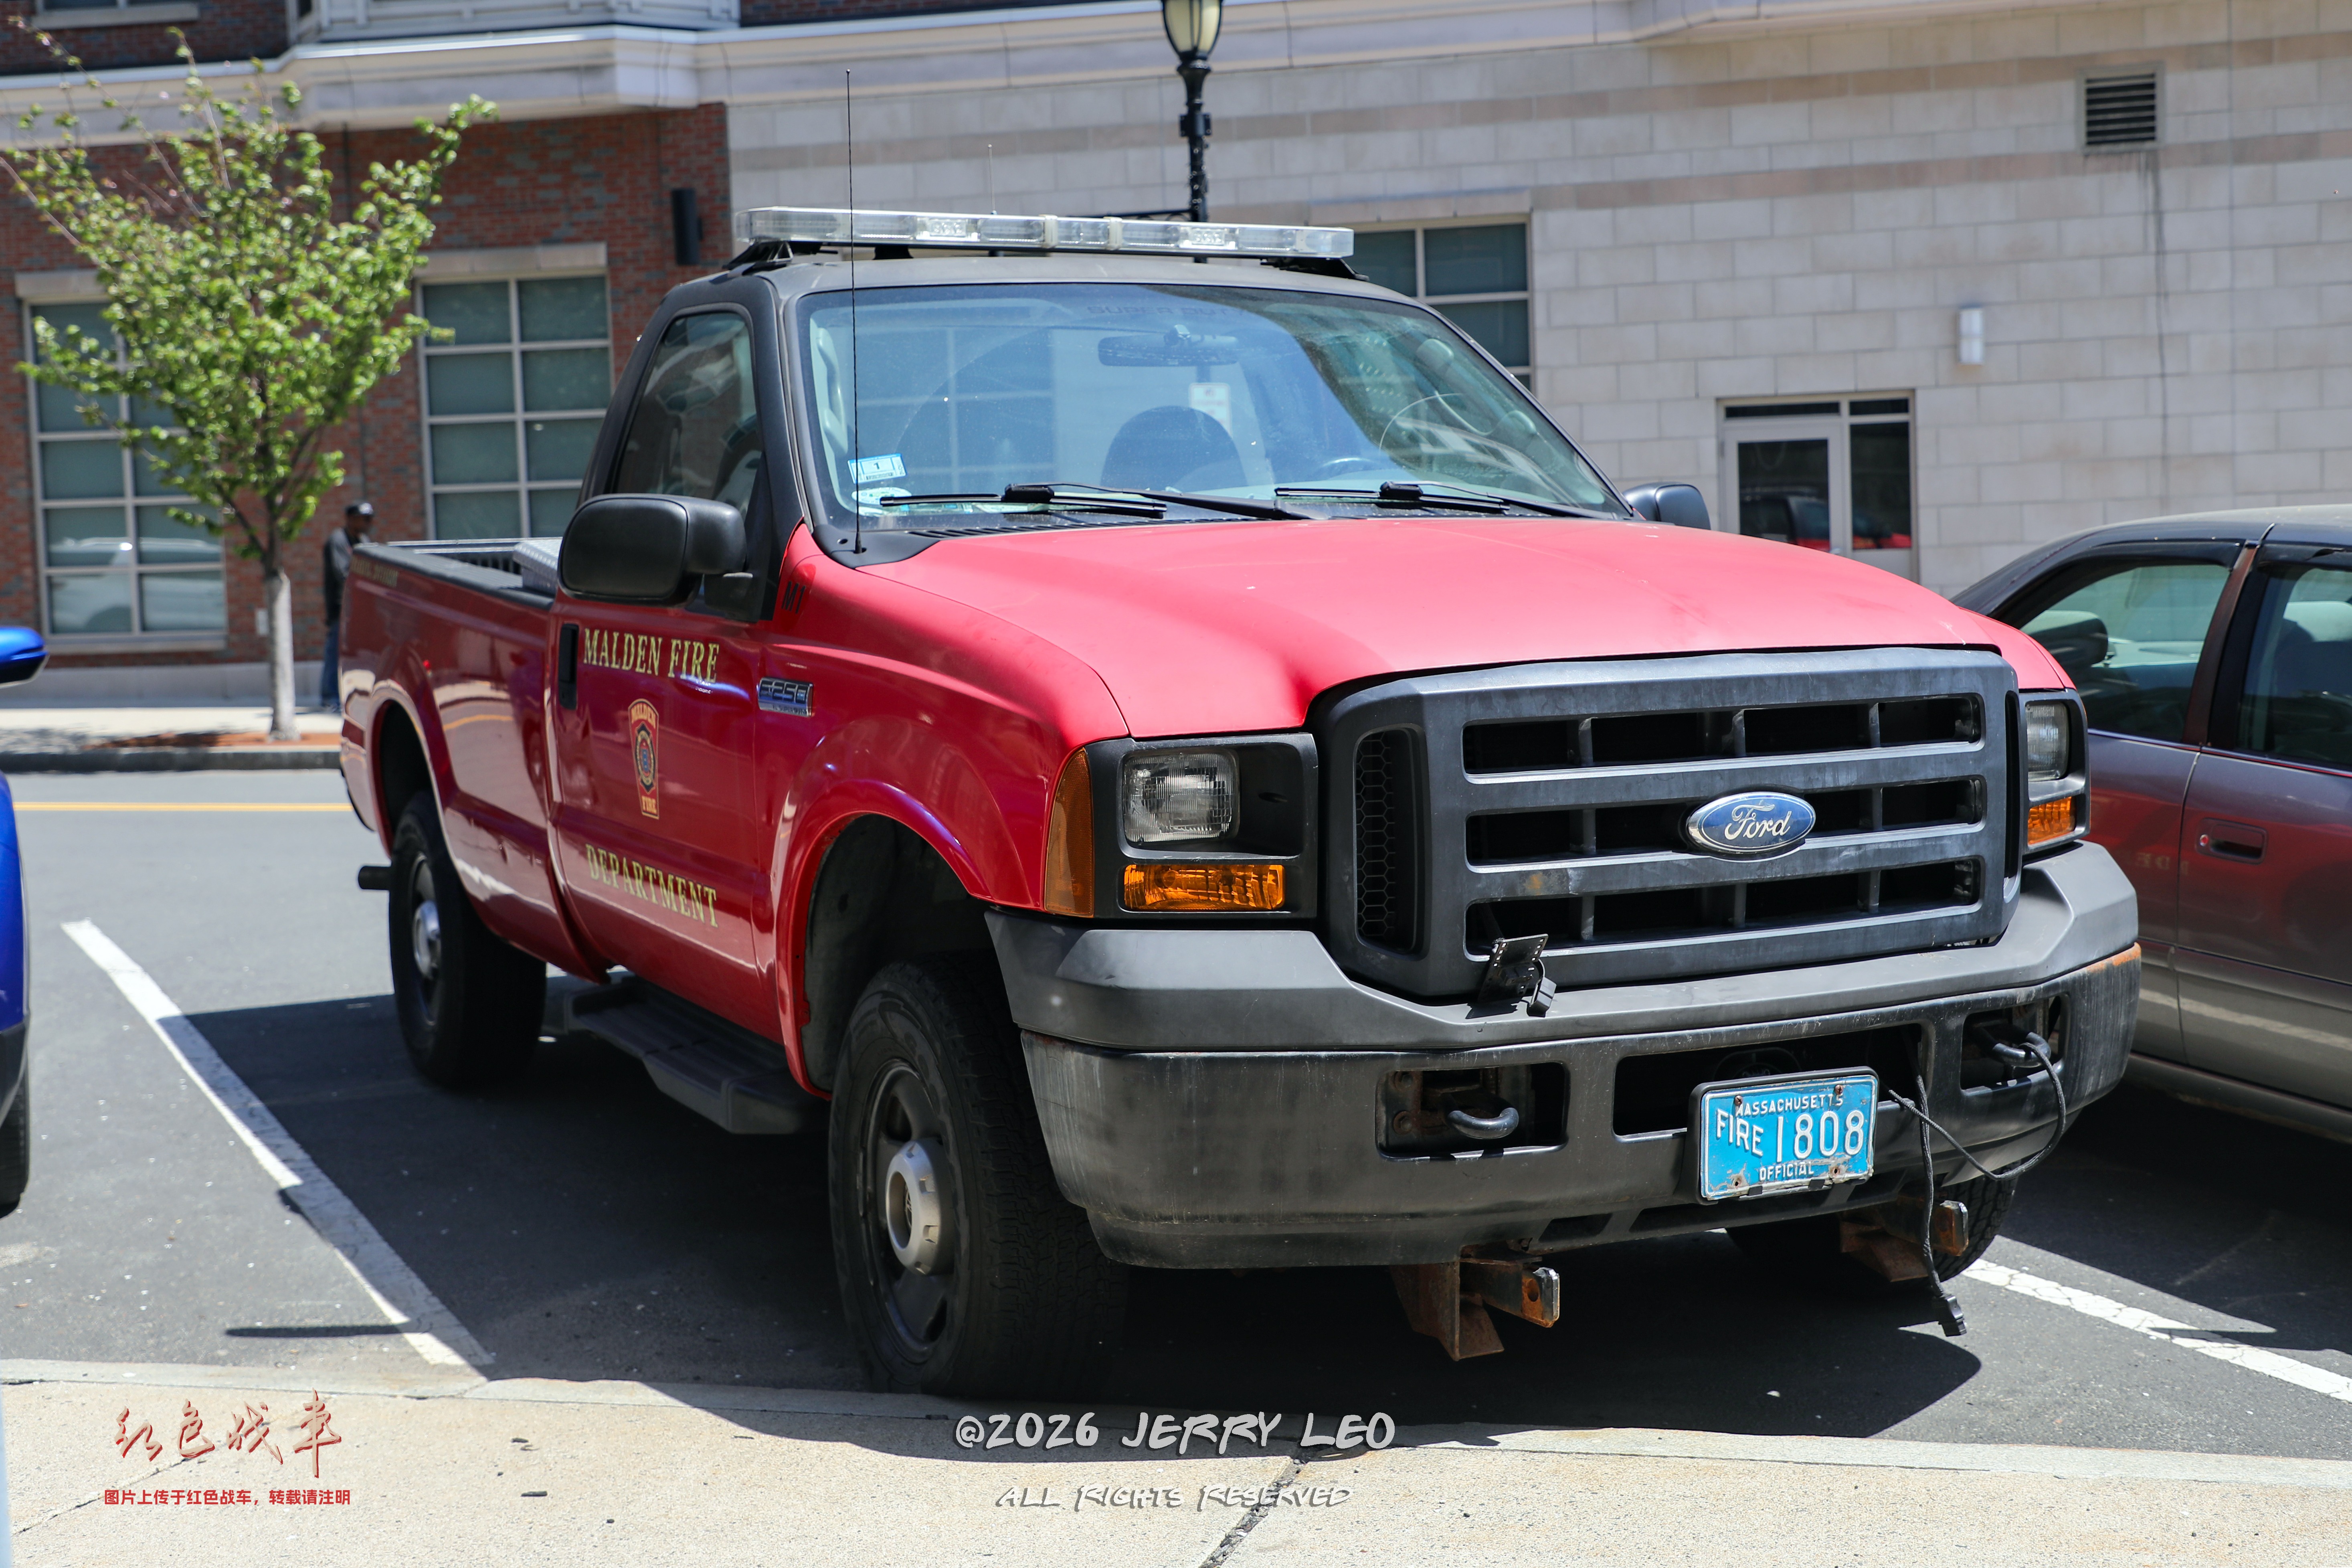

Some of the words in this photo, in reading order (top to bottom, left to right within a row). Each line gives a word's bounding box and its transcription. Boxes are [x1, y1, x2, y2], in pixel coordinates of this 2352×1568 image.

[781, 580, 807, 615] M1
[584, 628, 663, 676] MALDEN
[667, 639, 719, 684] FIRE
[1724, 804, 1792, 841] Ford
[585, 843, 718, 929] DEPARTMENT
[1735, 1093, 1843, 1117] MASSACHUSETTS
[1716, 1108, 1763, 1157] FIRE
[1777, 1110, 1863, 1163] 1808
[1759, 1161, 1815, 1182] OFFICIAL
